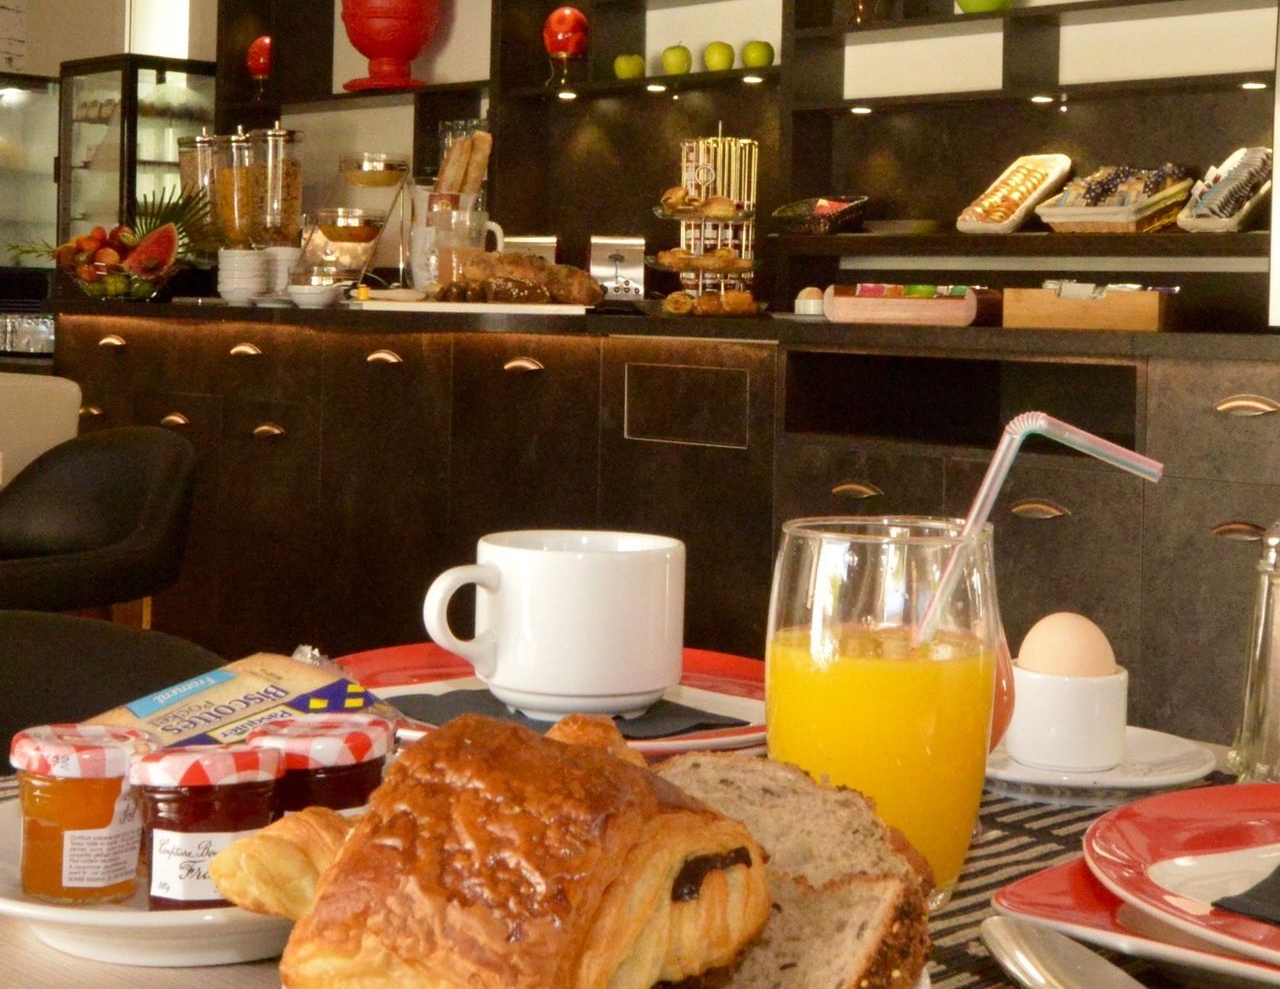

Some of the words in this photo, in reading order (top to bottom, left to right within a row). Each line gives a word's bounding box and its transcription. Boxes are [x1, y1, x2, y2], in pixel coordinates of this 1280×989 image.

[153, 676, 216, 704] Froment
[146, 700, 216, 727] Pocket
[160, 684, 290, 735] Biscottes
[220, 709, 293, 739] Pasquier
